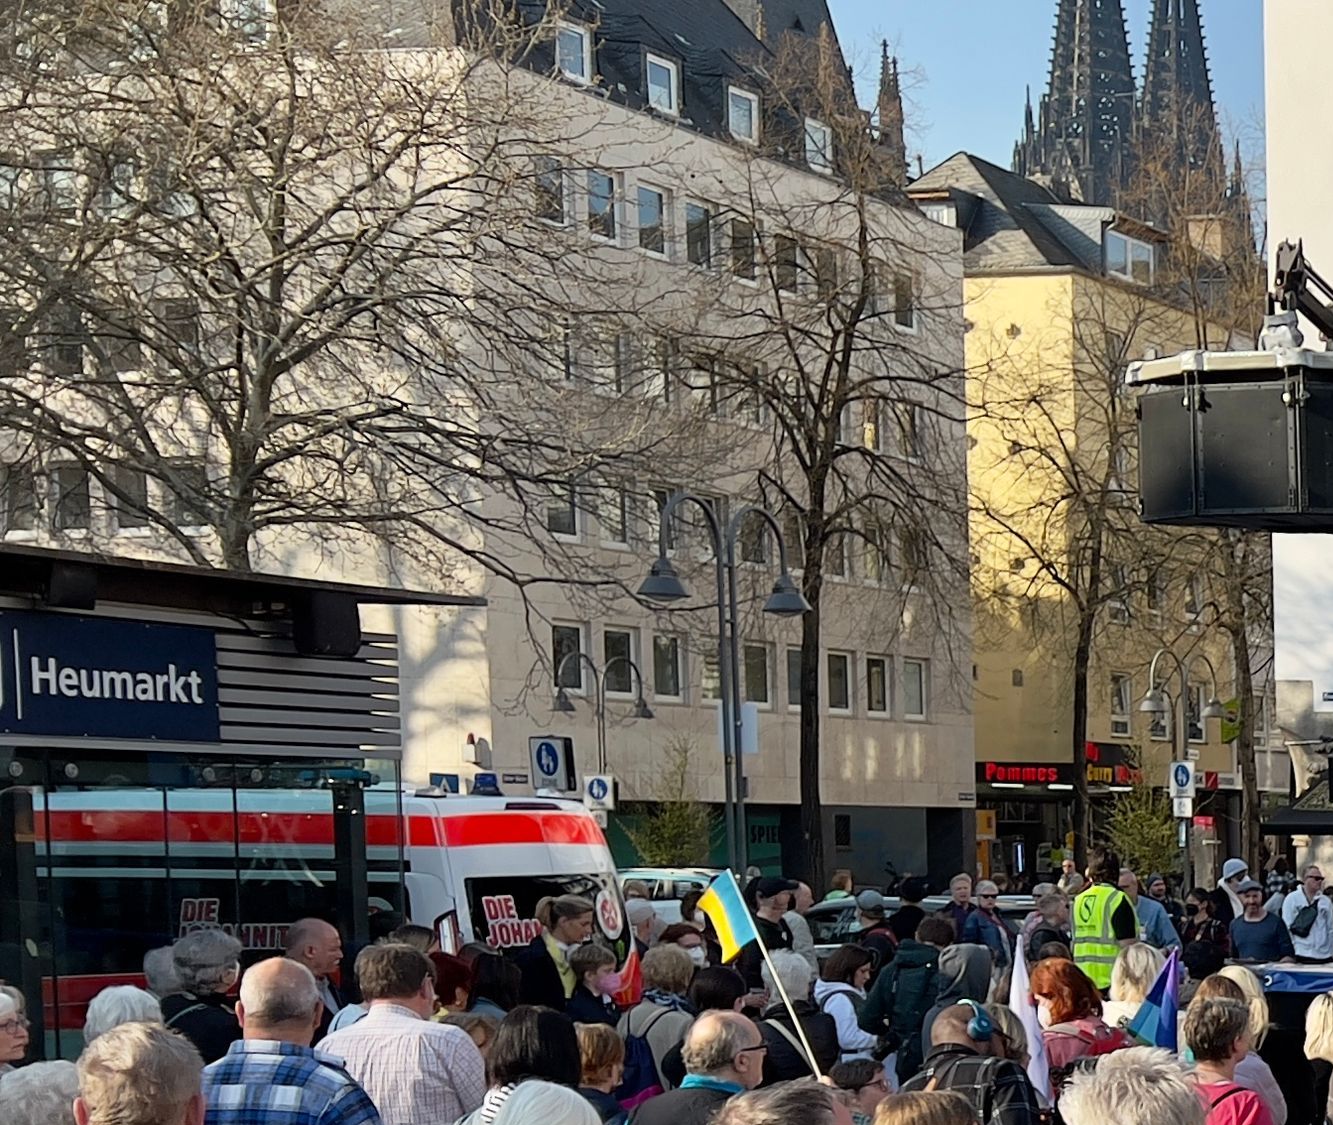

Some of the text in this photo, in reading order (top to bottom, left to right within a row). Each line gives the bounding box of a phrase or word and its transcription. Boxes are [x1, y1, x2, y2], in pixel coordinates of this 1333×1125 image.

[31, 656, 204, 704] Heumarkt
[986, 763, 1058, 782] Pommes
[183, 900, 219, 922] DIE
[483, 896, 517, 920] DIE
